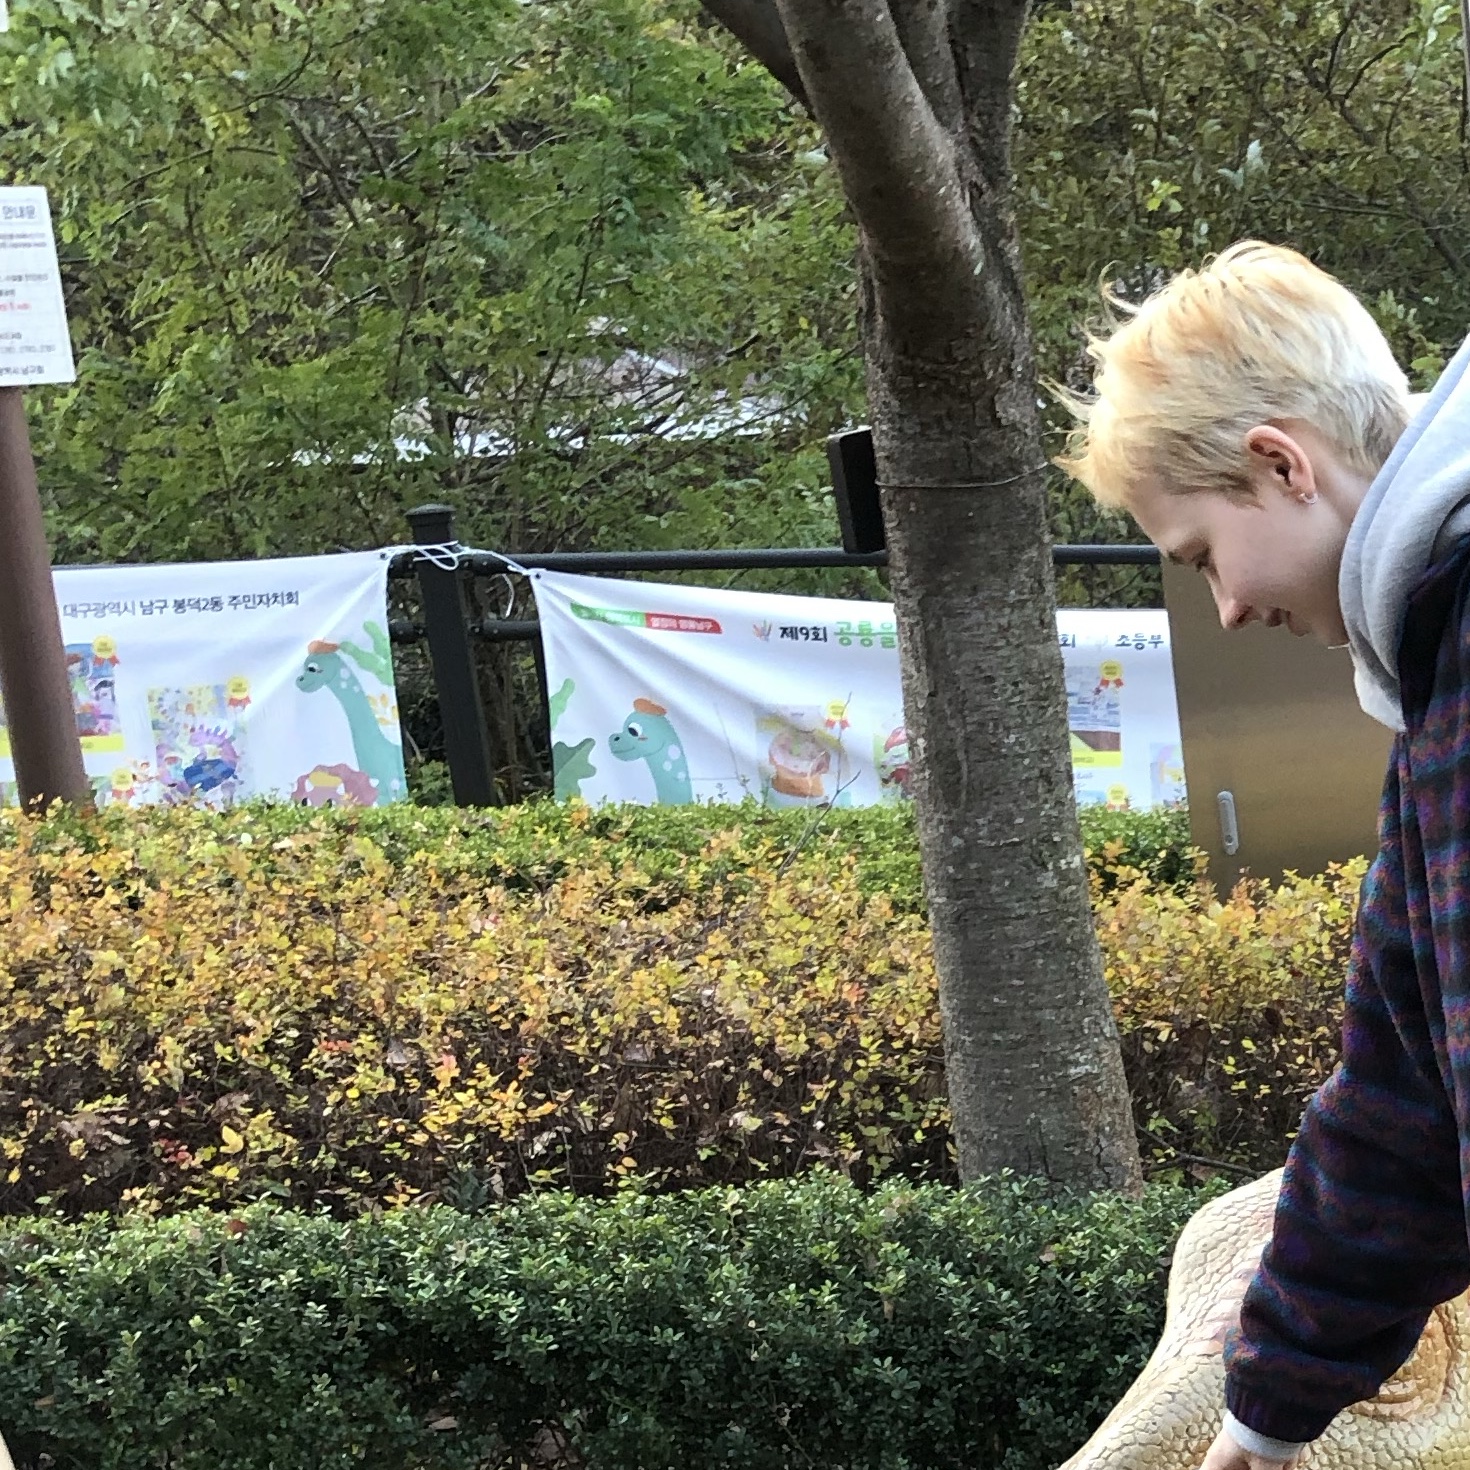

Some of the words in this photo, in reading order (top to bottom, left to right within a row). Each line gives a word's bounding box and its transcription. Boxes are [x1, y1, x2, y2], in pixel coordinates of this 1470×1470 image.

[62, 601, 136, 619] 대구광역시
[139, 598, 169, 616] 남구
[172, 595, 224, 614] 봉덕2동
[227, 589, 300, 611] 주민자치회
[779, 626, 828, 643] 제9회
[833, 620, 898, 649] 공룡을
[1115, 632, 1165, 651] 초등부
